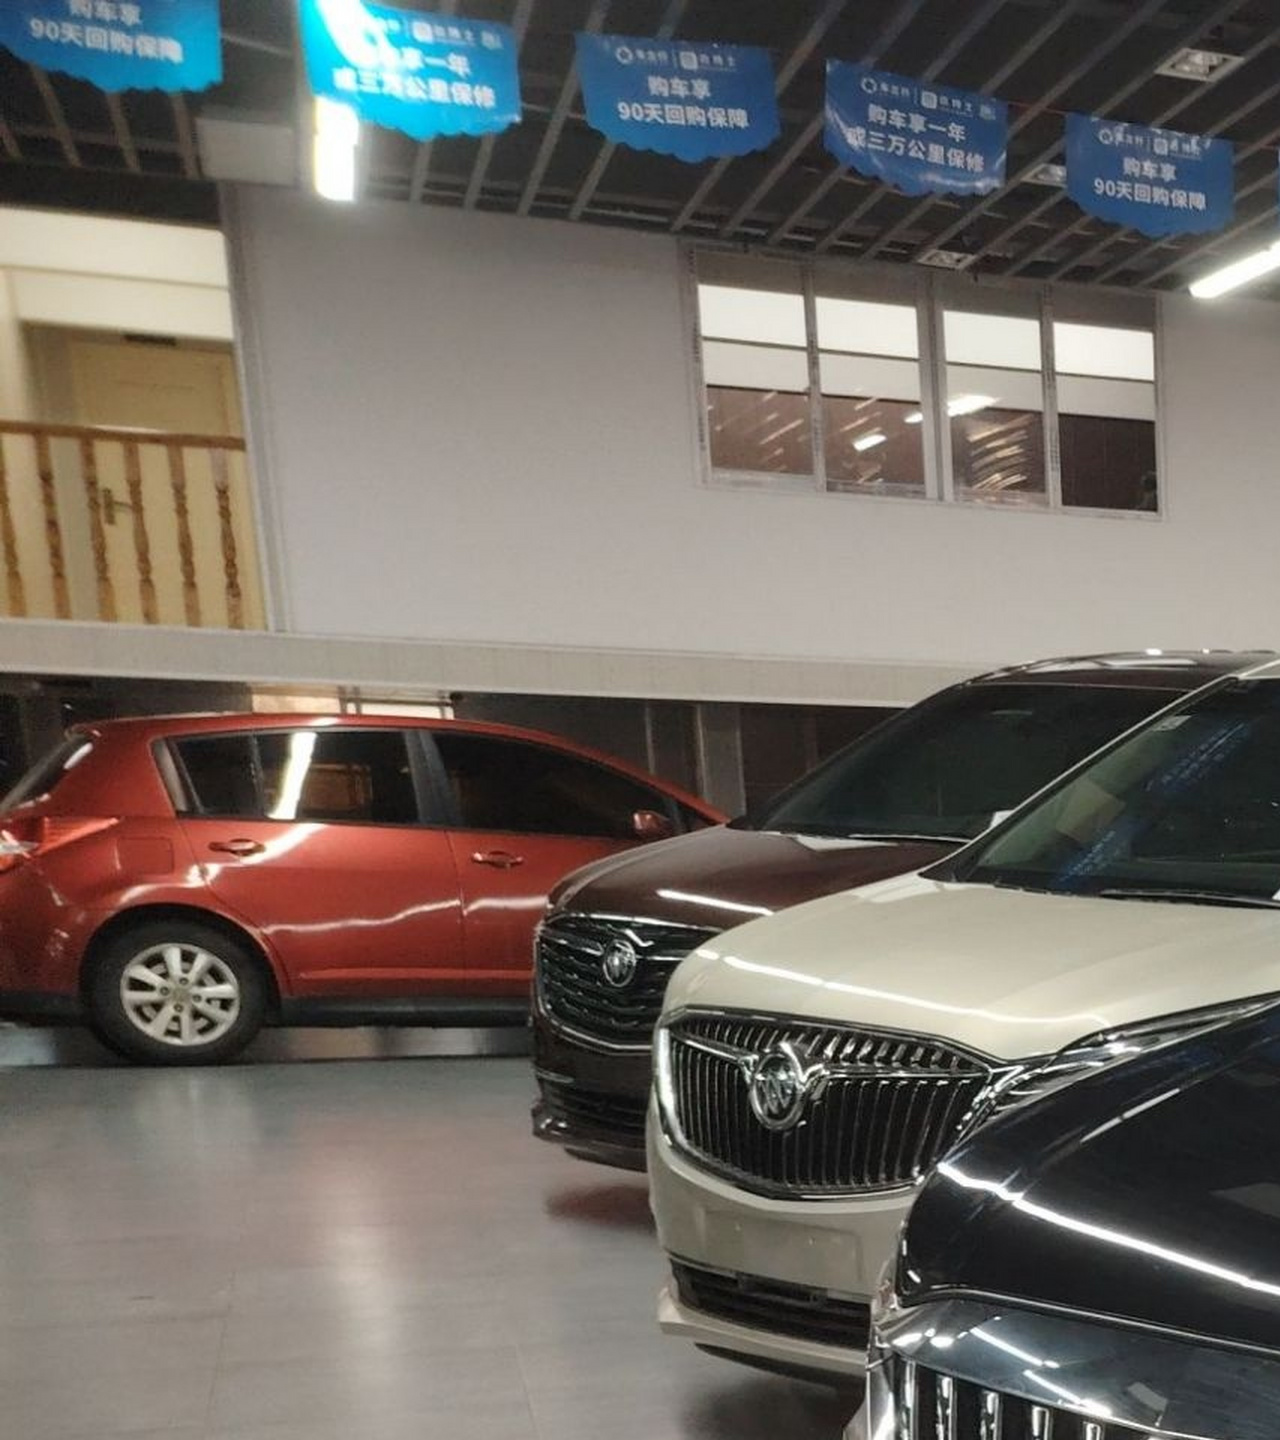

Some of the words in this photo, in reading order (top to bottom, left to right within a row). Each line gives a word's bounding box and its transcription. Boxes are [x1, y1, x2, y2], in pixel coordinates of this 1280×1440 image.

[648, 76, 711, 99] 购车享
[617, 101, 749, 128] 90天回购保障
[868, 103, 966, 143] 购车享一年
[846, 127, 984, 173] 或三万公里保修
[1123, 157, 1177, 182] 购车享
[1094, 178, 1207, 210] 90天回购保障
